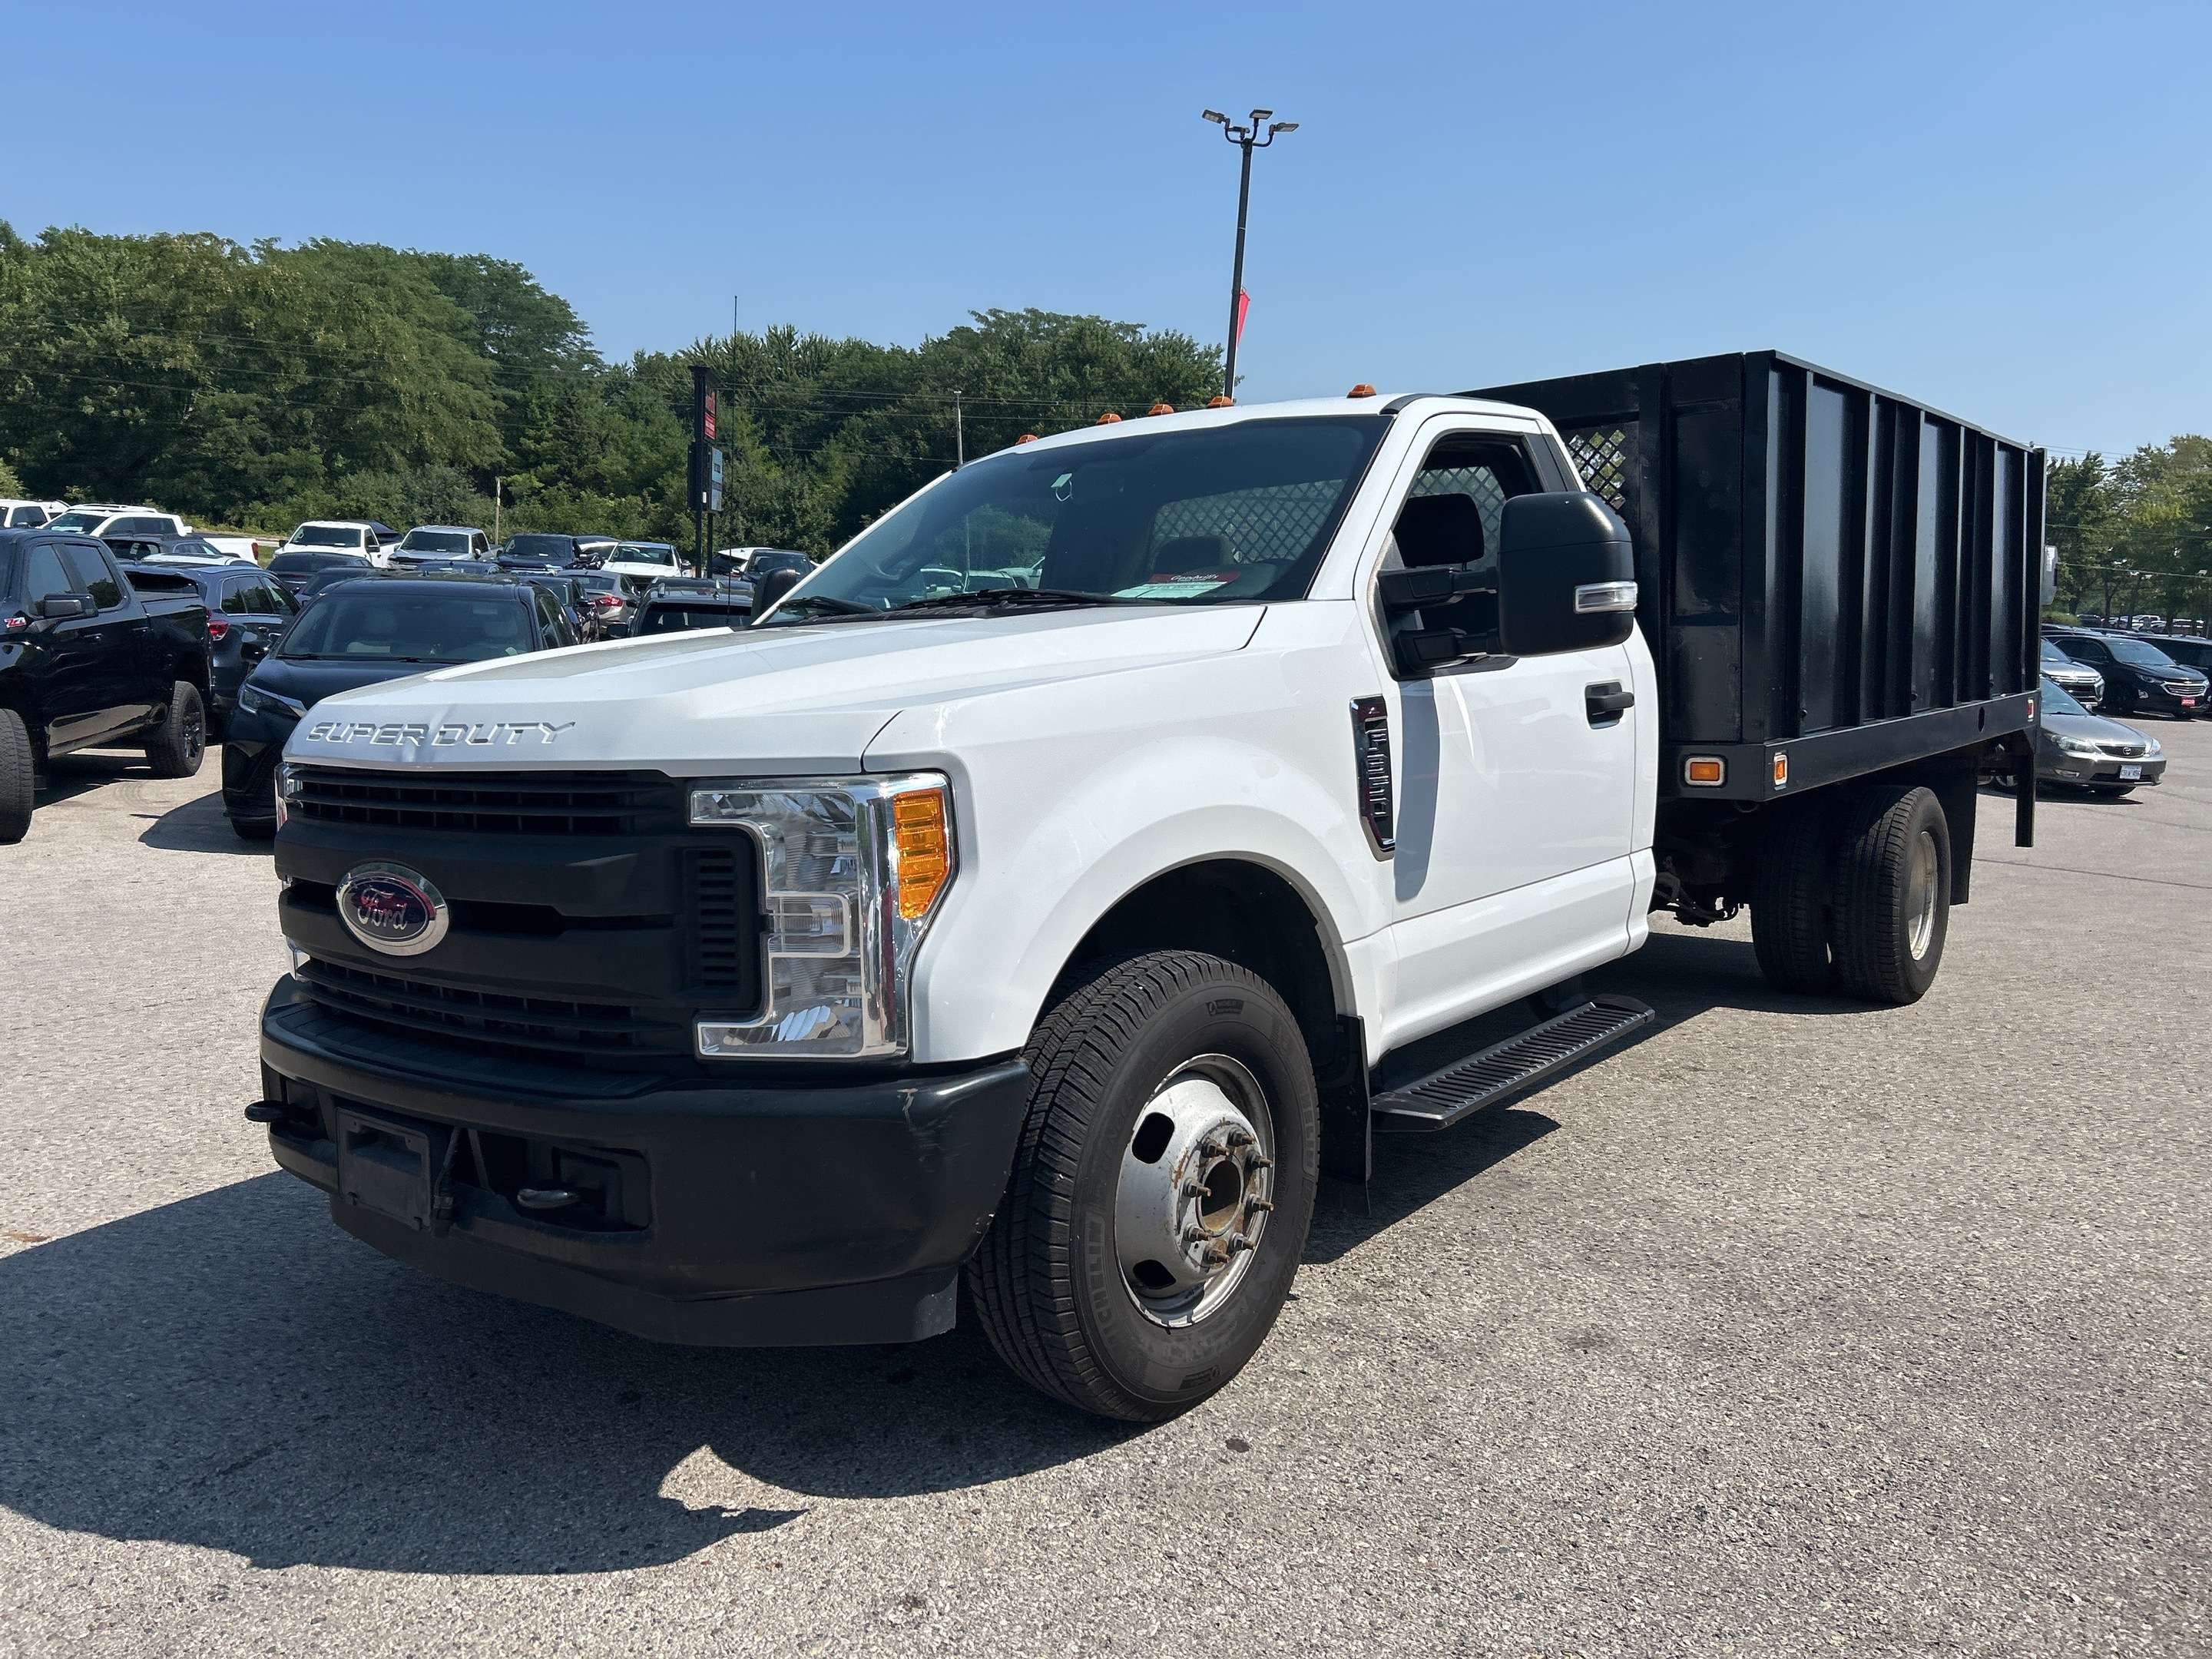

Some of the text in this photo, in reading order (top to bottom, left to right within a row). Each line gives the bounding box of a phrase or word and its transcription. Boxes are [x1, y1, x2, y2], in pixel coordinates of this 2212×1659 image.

[306, 720, 577, 747] SUPER DUTY
[358, 887, 408, 930] Ford
